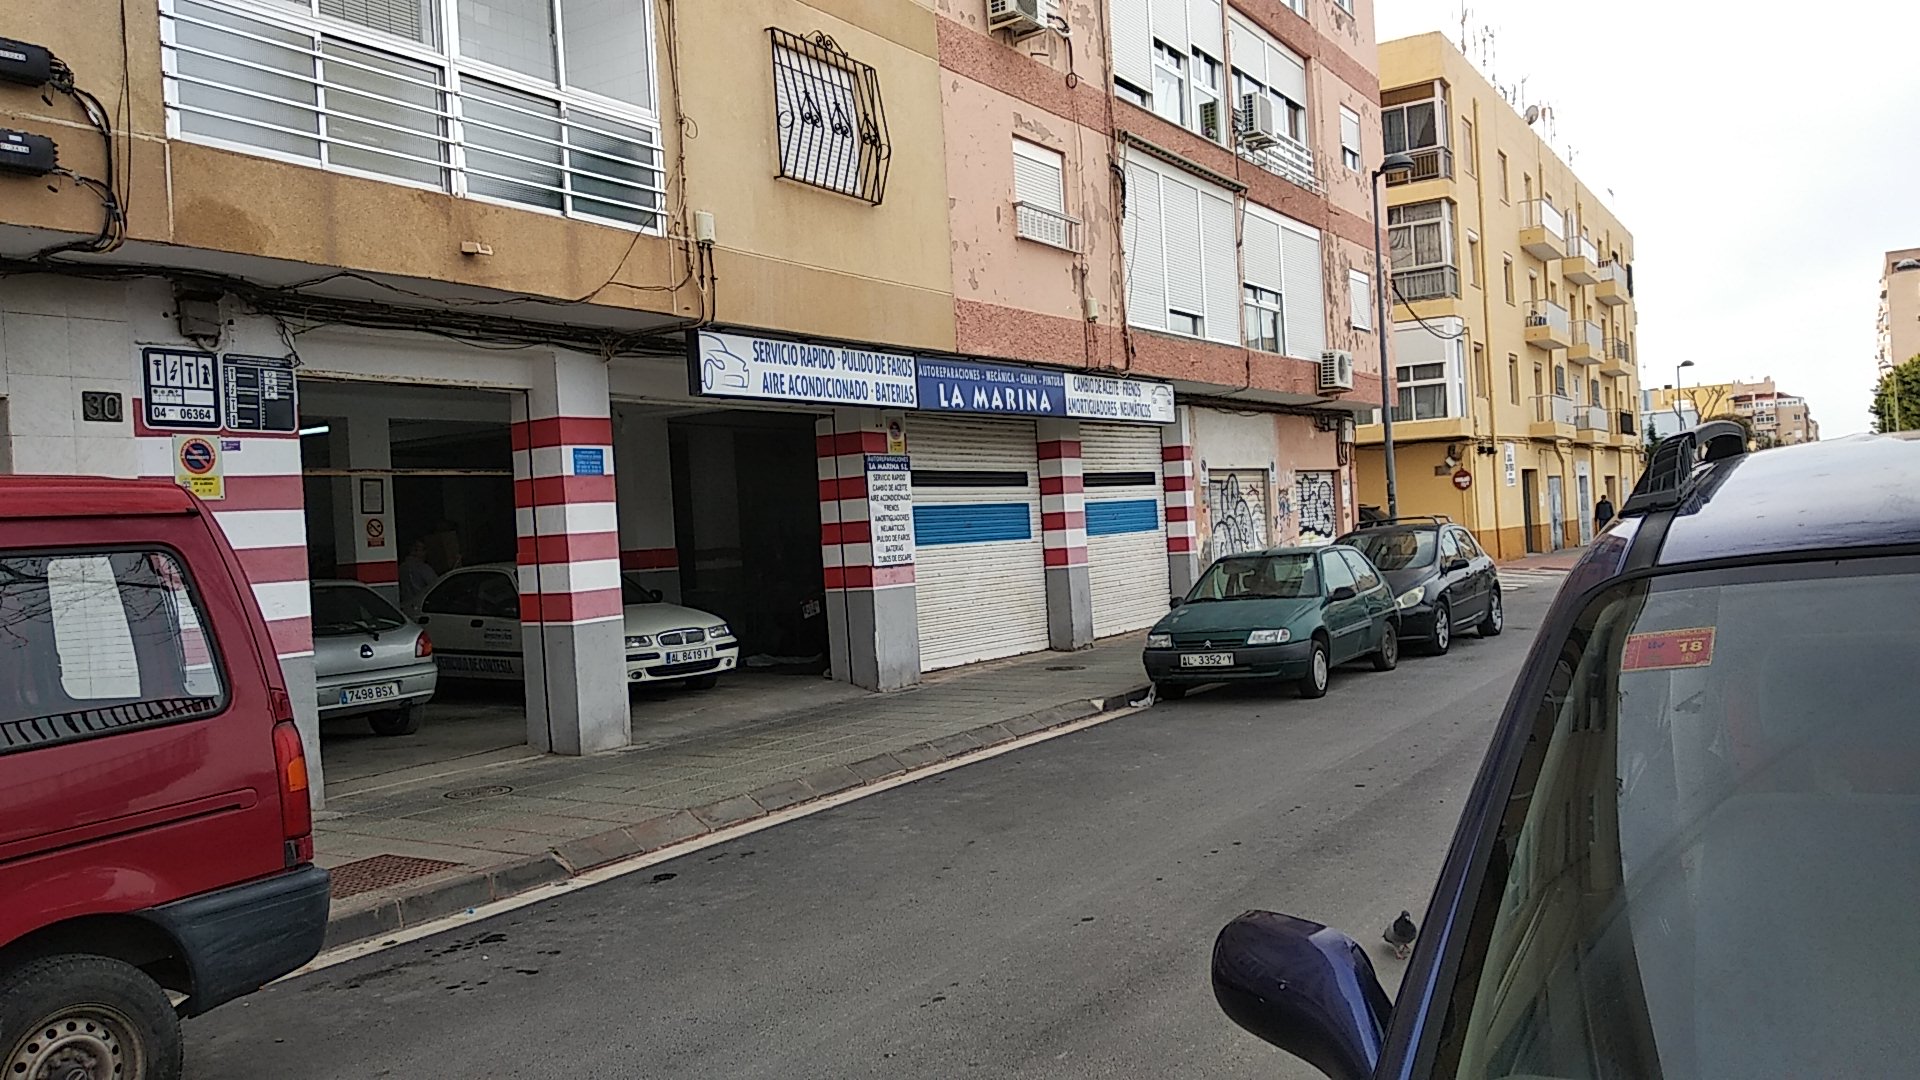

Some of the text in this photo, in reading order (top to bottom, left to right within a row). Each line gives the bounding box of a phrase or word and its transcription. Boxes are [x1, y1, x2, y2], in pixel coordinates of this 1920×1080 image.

[753, 340, 913, 378] SERVICIO RAPIDO PULIDO DE FAROS
[918, 364, 981, 381] AUTOREPARACIONES
[1020, 373, 1038, 384] CHAPA
[1043, 375, 1064, 387] PINTURA
[762, 371, 915, 405] AIRE ACONDICIONADO BATERIAS
[1073, 375, 1141, 397] CAMBIO DE ACEITE FRENOS
[84, 393, 121, 420] 30
[938, 383, 1052, 413] LA MARINA
[1067, 397, 1118, 416] AMORTIGUADORES
[153, 406, 212, 420] 04 06364
[868, 462, 877, 471] LA
[877, 463, 900, 471] MARINA
[883, 504, 900, 512] FRENOS
[671, 649, 709, 662] AL 8419 Y
[1679, 640, 1704, 653] 18
[348, 684, 395, 702] 7498 BSX
